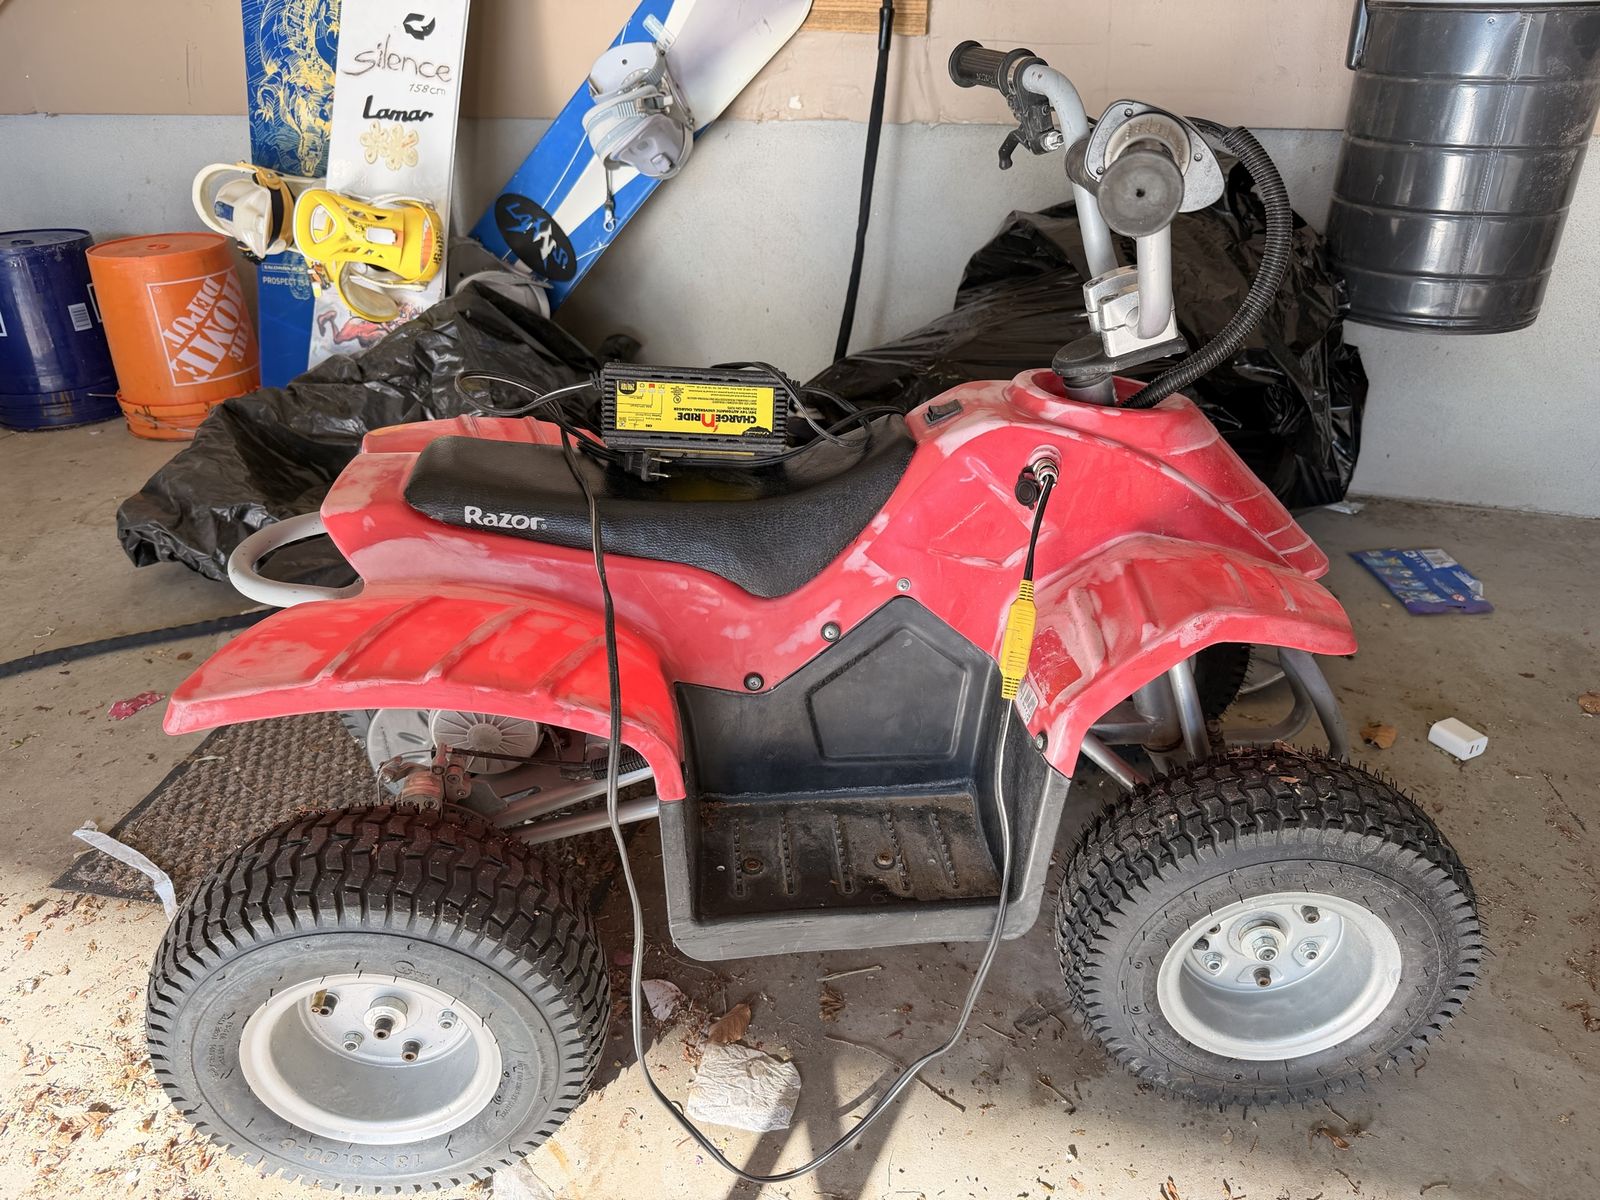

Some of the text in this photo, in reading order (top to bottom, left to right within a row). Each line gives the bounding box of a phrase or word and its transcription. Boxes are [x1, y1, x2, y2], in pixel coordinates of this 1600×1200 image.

[362, 95, 434, 122] Lamar
[163, 276, 222, 349] DEPOT
[169, 271, 244, 383] HOME
[464, 505, 545, 530] Razor
